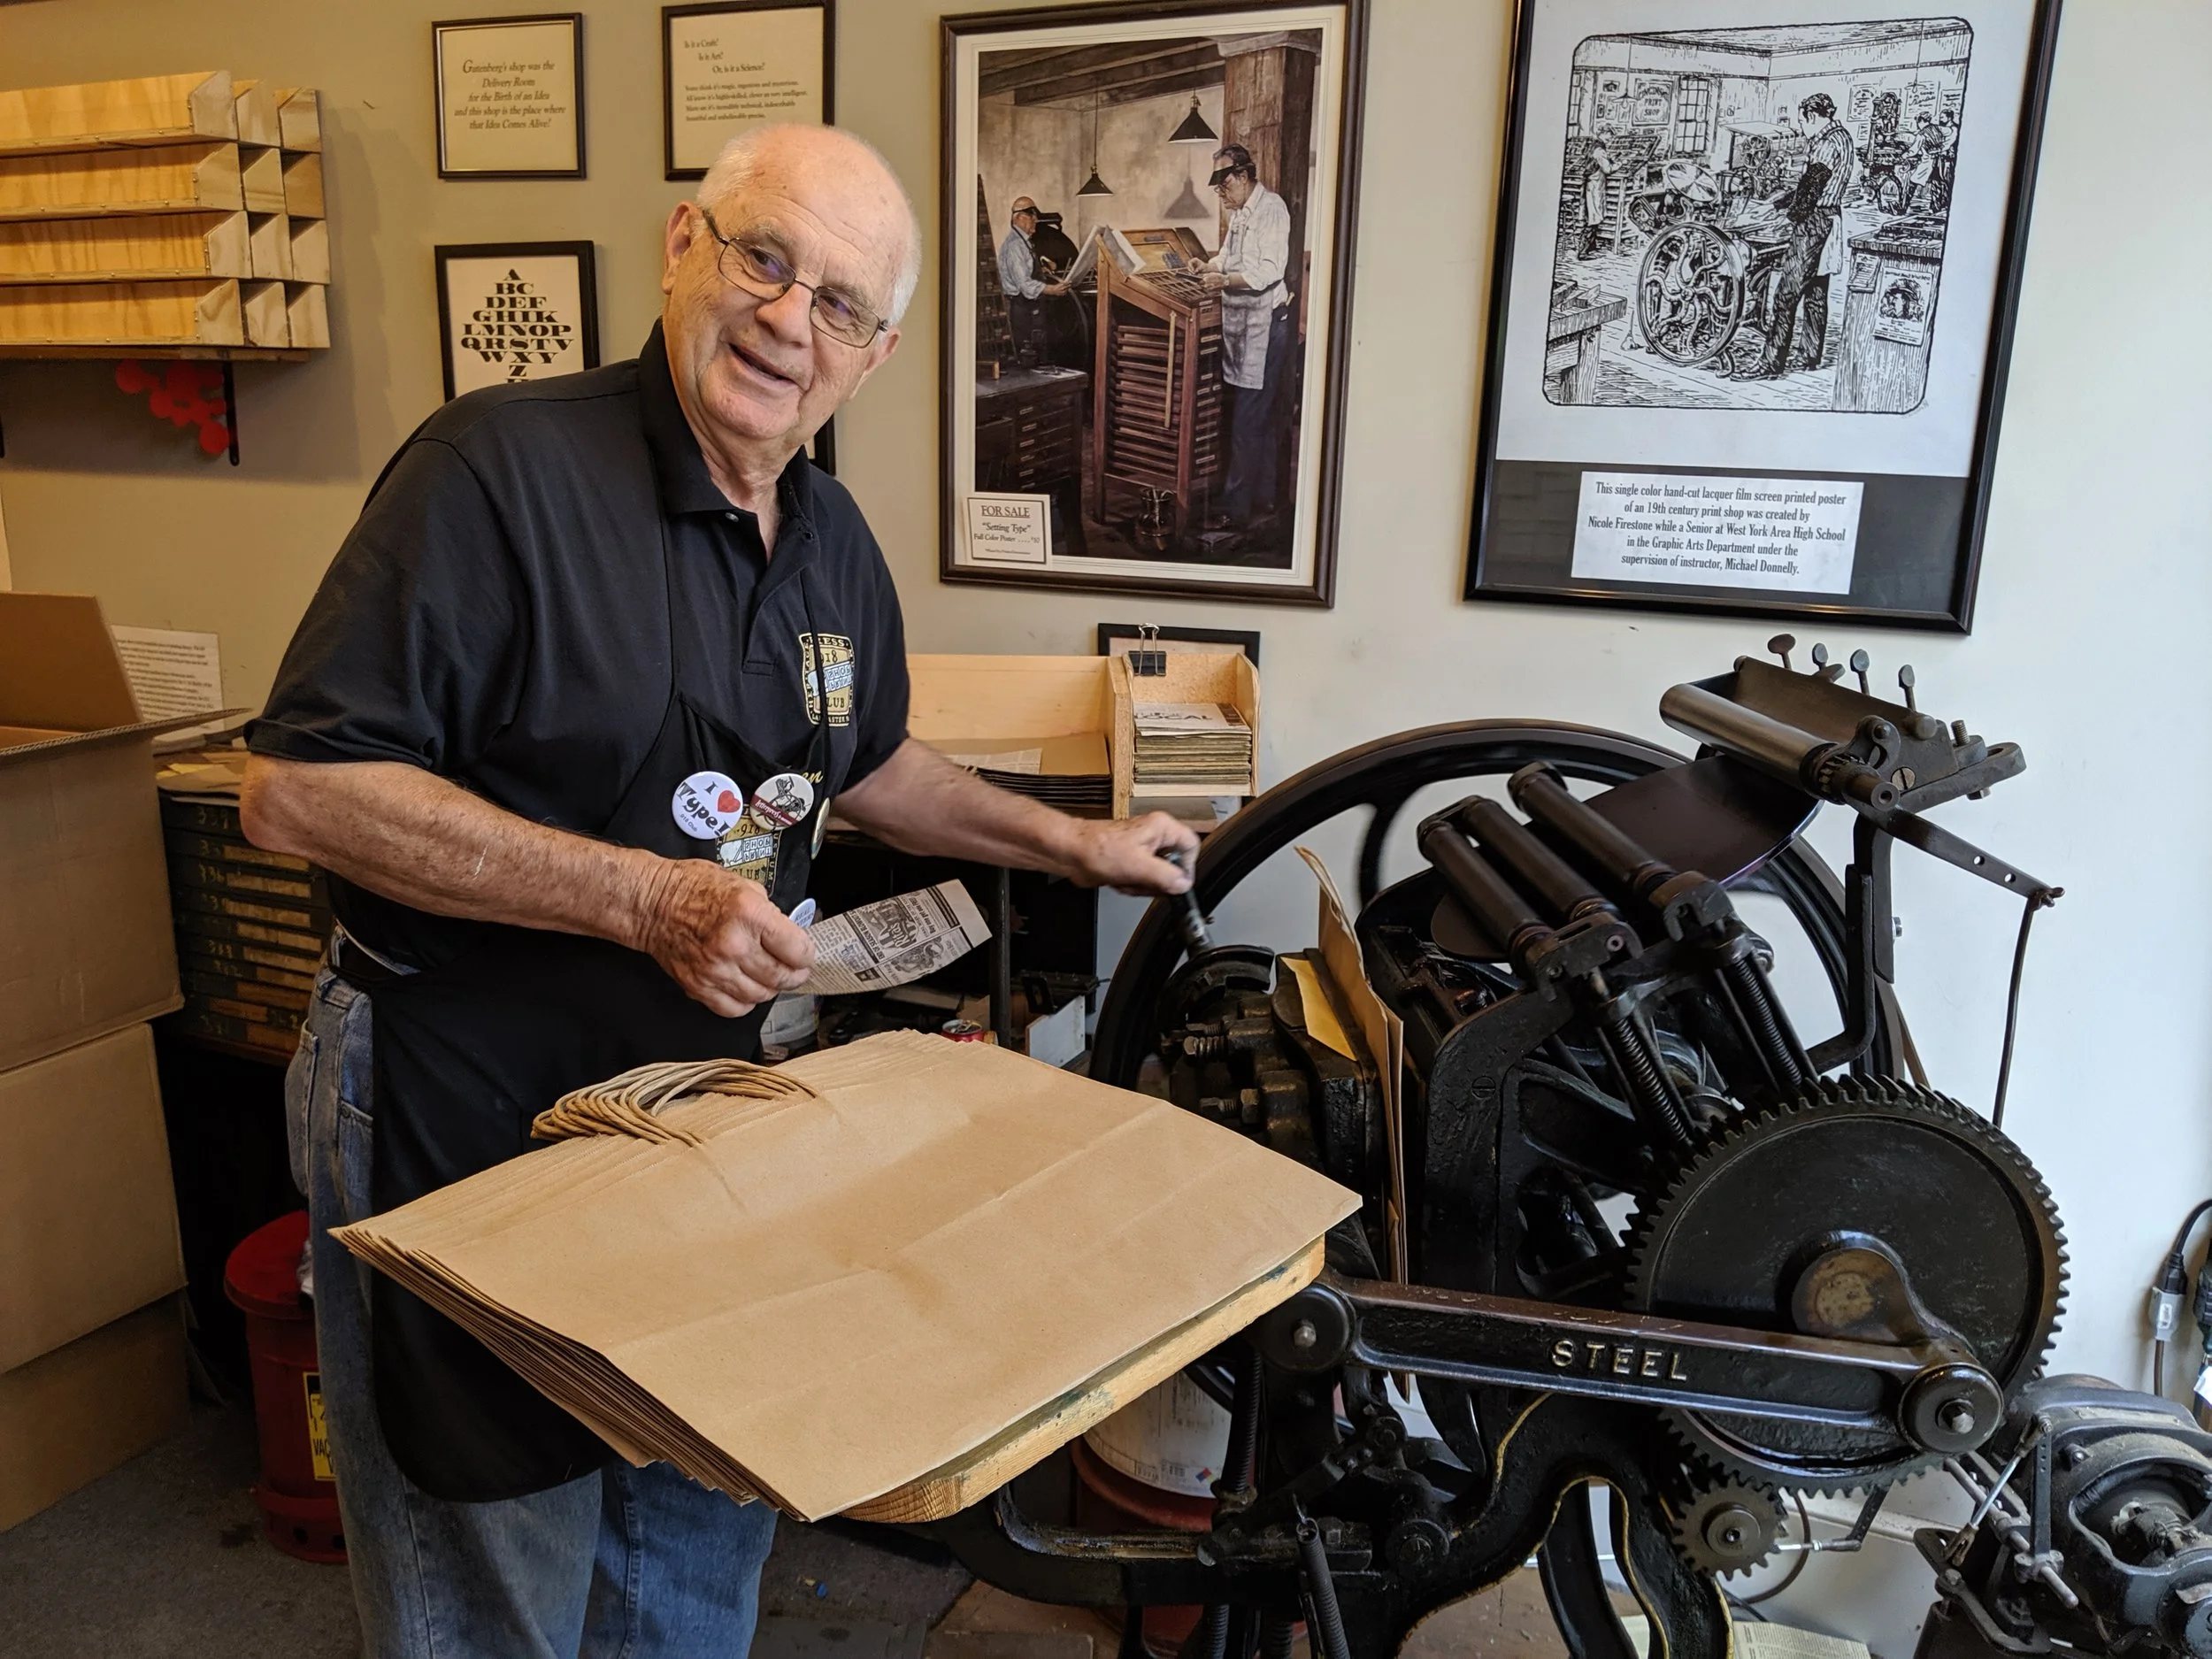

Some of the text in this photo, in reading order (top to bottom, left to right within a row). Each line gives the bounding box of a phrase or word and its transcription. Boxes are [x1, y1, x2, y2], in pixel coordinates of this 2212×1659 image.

[463, 59, 507, 73] Gutenberg's
[510, 62, 526, 73] shop
[542, 60, 556, 70] the
[482, 77, 535, 88] Delivery Room
[467, 92, 480, 102] for
[480, 92, 492, 101] the
[494, 91, 512, 101] Birth
[514, 91, 523, 101] of
[534, 90, 549, 100] Idea
[454, 107, 468, 116] and
[469, 107, 481, 116] this
[484, 106, 501, 118] shop
[510, 105, 521, 115] the
[522, 104, 541, 117] place
[543, 104, 565, 114] where
[469, 119, 551, 129] that Idea Comes Alive!
[503, 269, 522, 280] A
[495, 282, 534, 295] BC
[462, 324, 572, 337] LMNOP
[509, 365, 526, 377] Z
[1596, 481, 1847, 506] This single color hand-cut lacquer film screen printed poster
[981, 505, 1030, 518] FOR SALE
[1624, 500, 1810, 523] of an 19th century print shop was created by
[1588, 515, 1613, 528] Nicole
[1615, 517, 1653, 531] Firestone
[1655, 519, 1677, 532] while
[1686, 520, 1713, 534] Senior
[1715, 526, 1723, 534] at
[1726, 523, 1746, 536] West
[1748, 523, 1768, 537] York
[1770, 525, 1791, 538] Area
[1793, 526, 1814, 541] High
[1816, 526, 1846, 541] School
[1627, 535, 1798, 557] in the Graphic Arts Department under the
[1621, 553, 1800, 576] supervision of instructor, Michael Donnelly.
[705, 780, 718, 795] I
[677, 780, 733, 837] Type!
[889, 922, 911, 949] Rita's
[1552, 1339, 1687, 1382] STEEL
